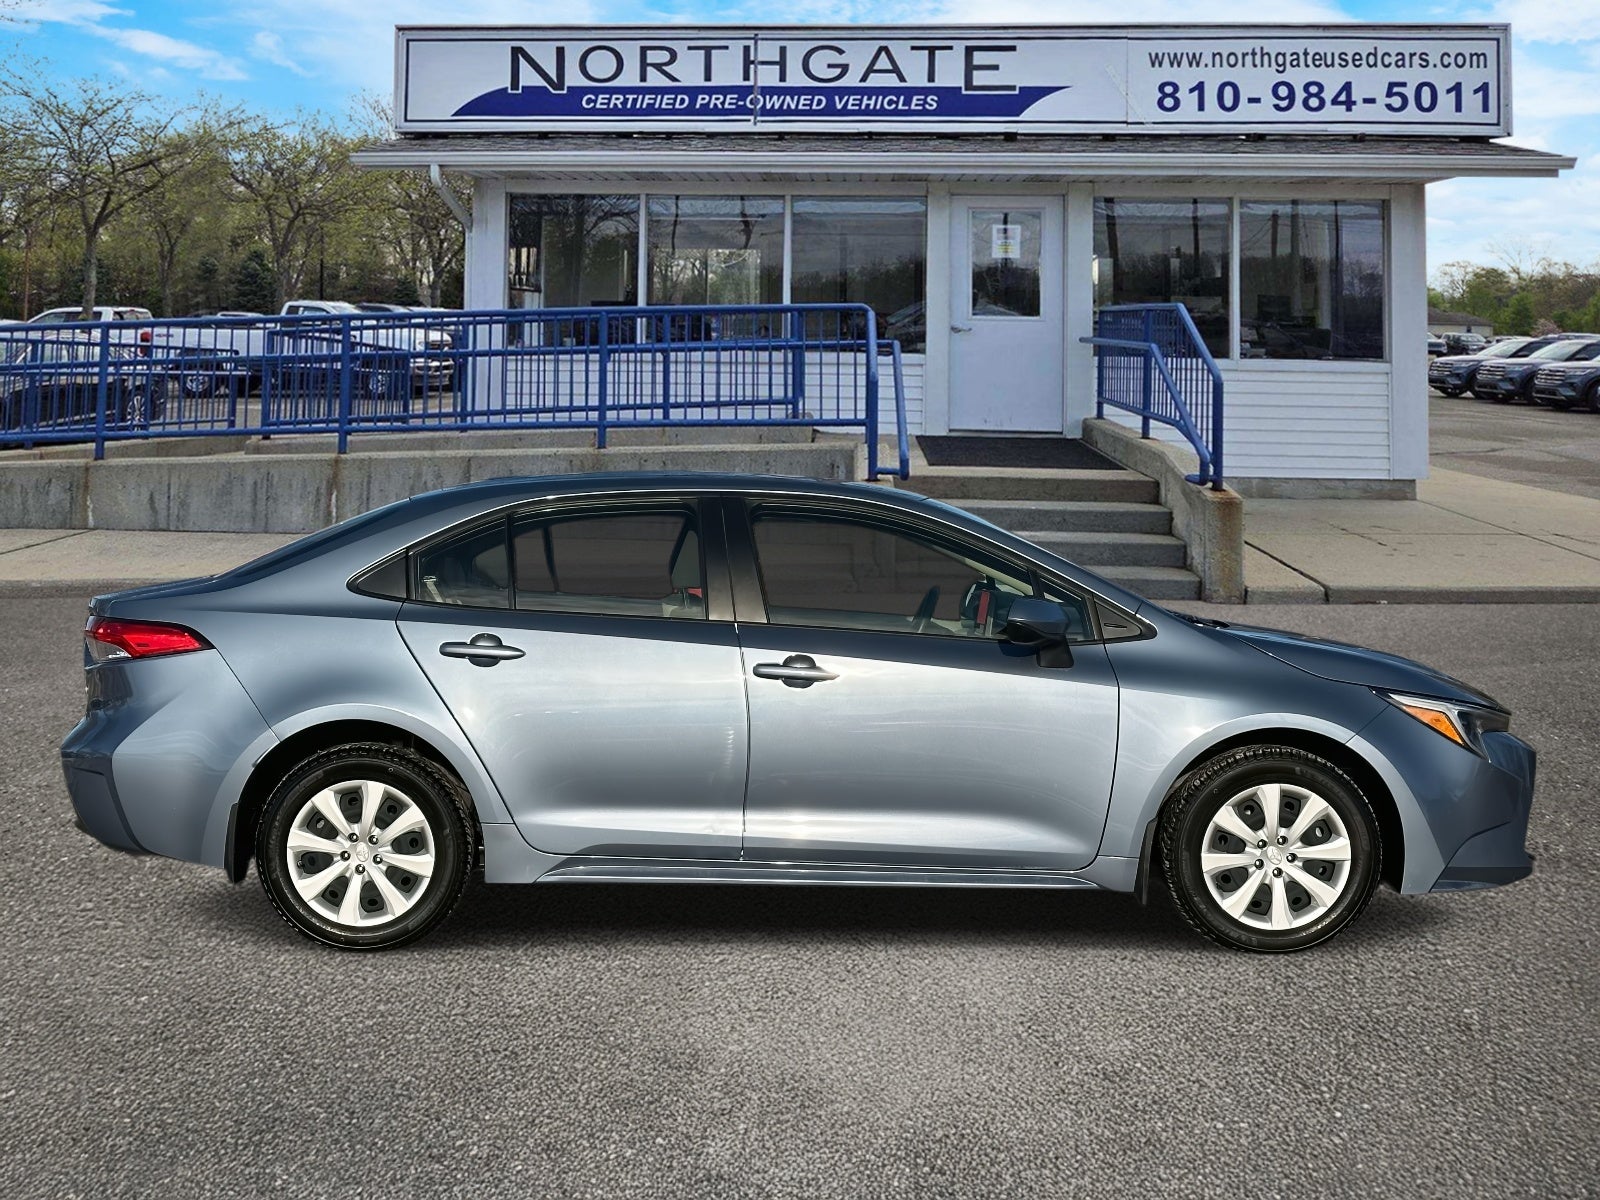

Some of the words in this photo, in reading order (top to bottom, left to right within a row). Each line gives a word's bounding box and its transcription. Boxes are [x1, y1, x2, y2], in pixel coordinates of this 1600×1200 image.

[509, 45, 1017, 92] NORTHGATE
[1149, 46, 1488, 74] www.northgateusedcars.com
[581, 93, 690, 110] CERTIFIED
[695, 94, 827, 110] PRE-OWNED
[834, 94, 938, 111] VEHICLES
[1156, 80, 1491, 113] 810-984-5011
